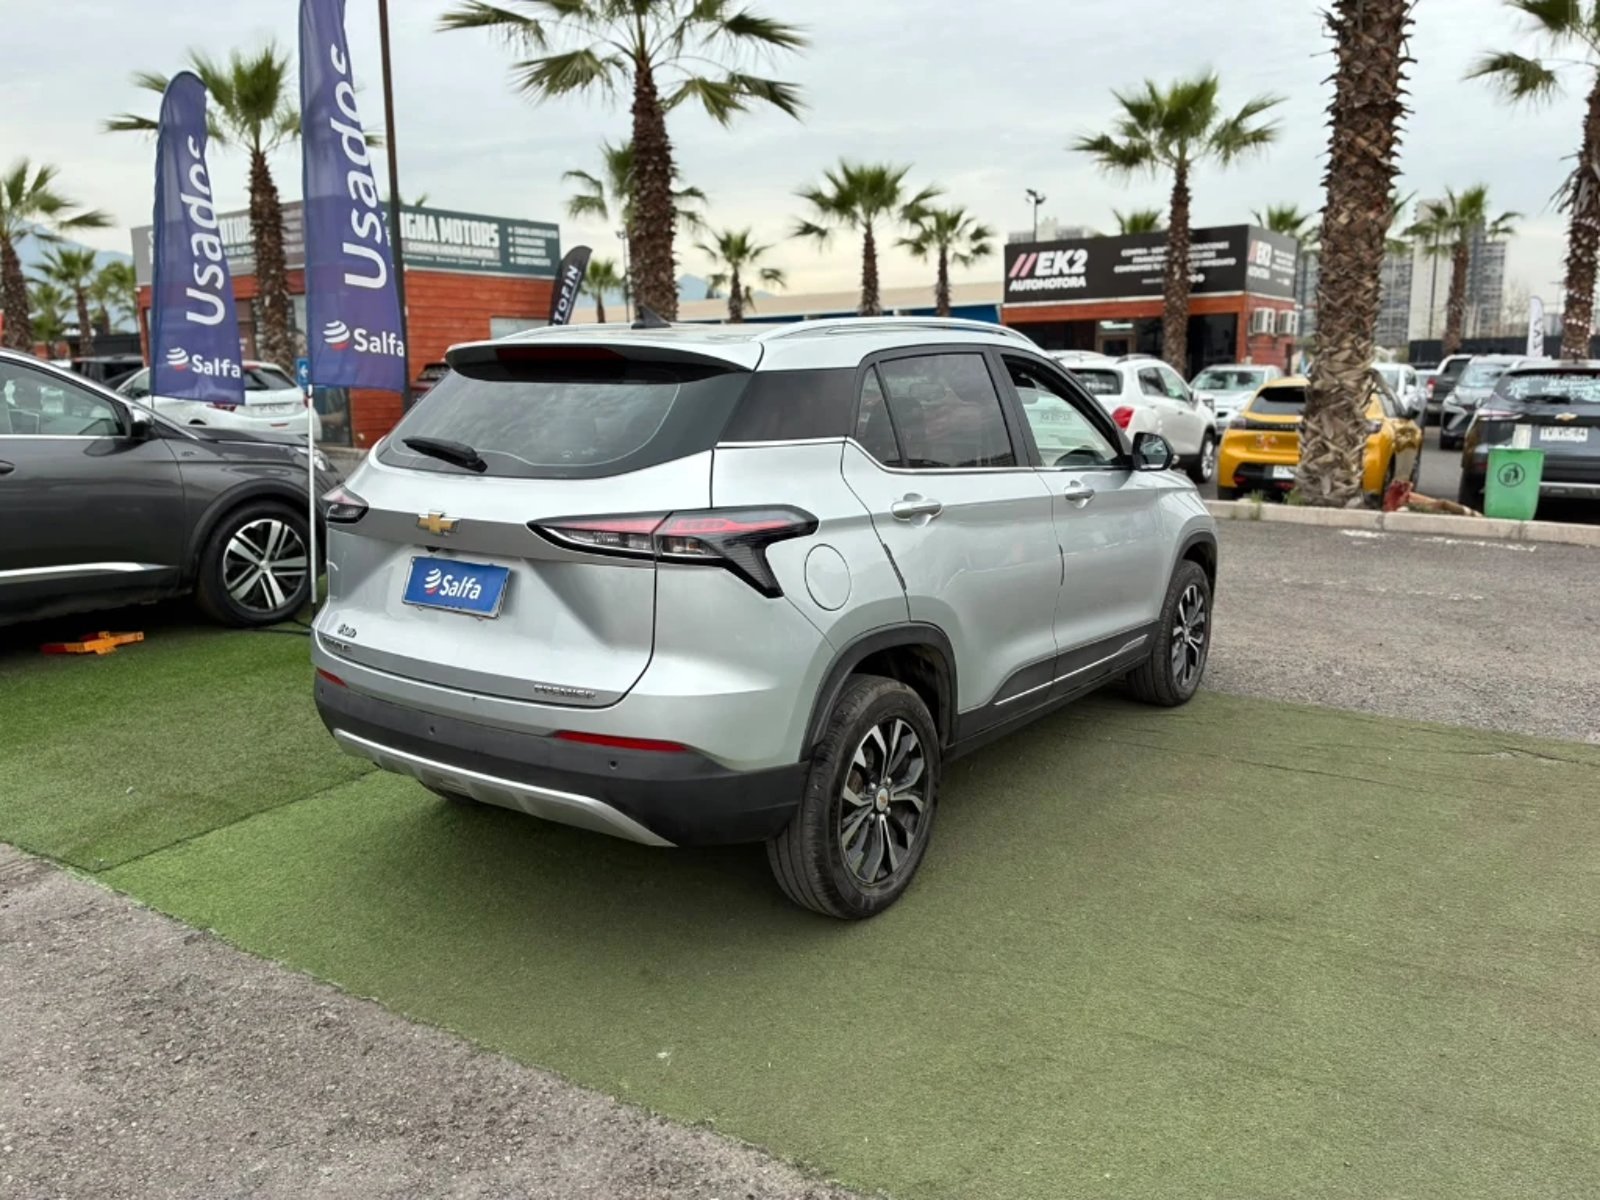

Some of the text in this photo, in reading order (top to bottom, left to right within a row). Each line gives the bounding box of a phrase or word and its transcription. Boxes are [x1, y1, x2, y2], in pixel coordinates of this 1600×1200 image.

[438, 216, 499, 248] MOTORS
[1009, 276, 1087, 292] AUTOMOTORA
[354, 328, 405, 358] Salfa
[191, 354, 241, 379] Salfa
[439, 574, 482, 600] Salfa
